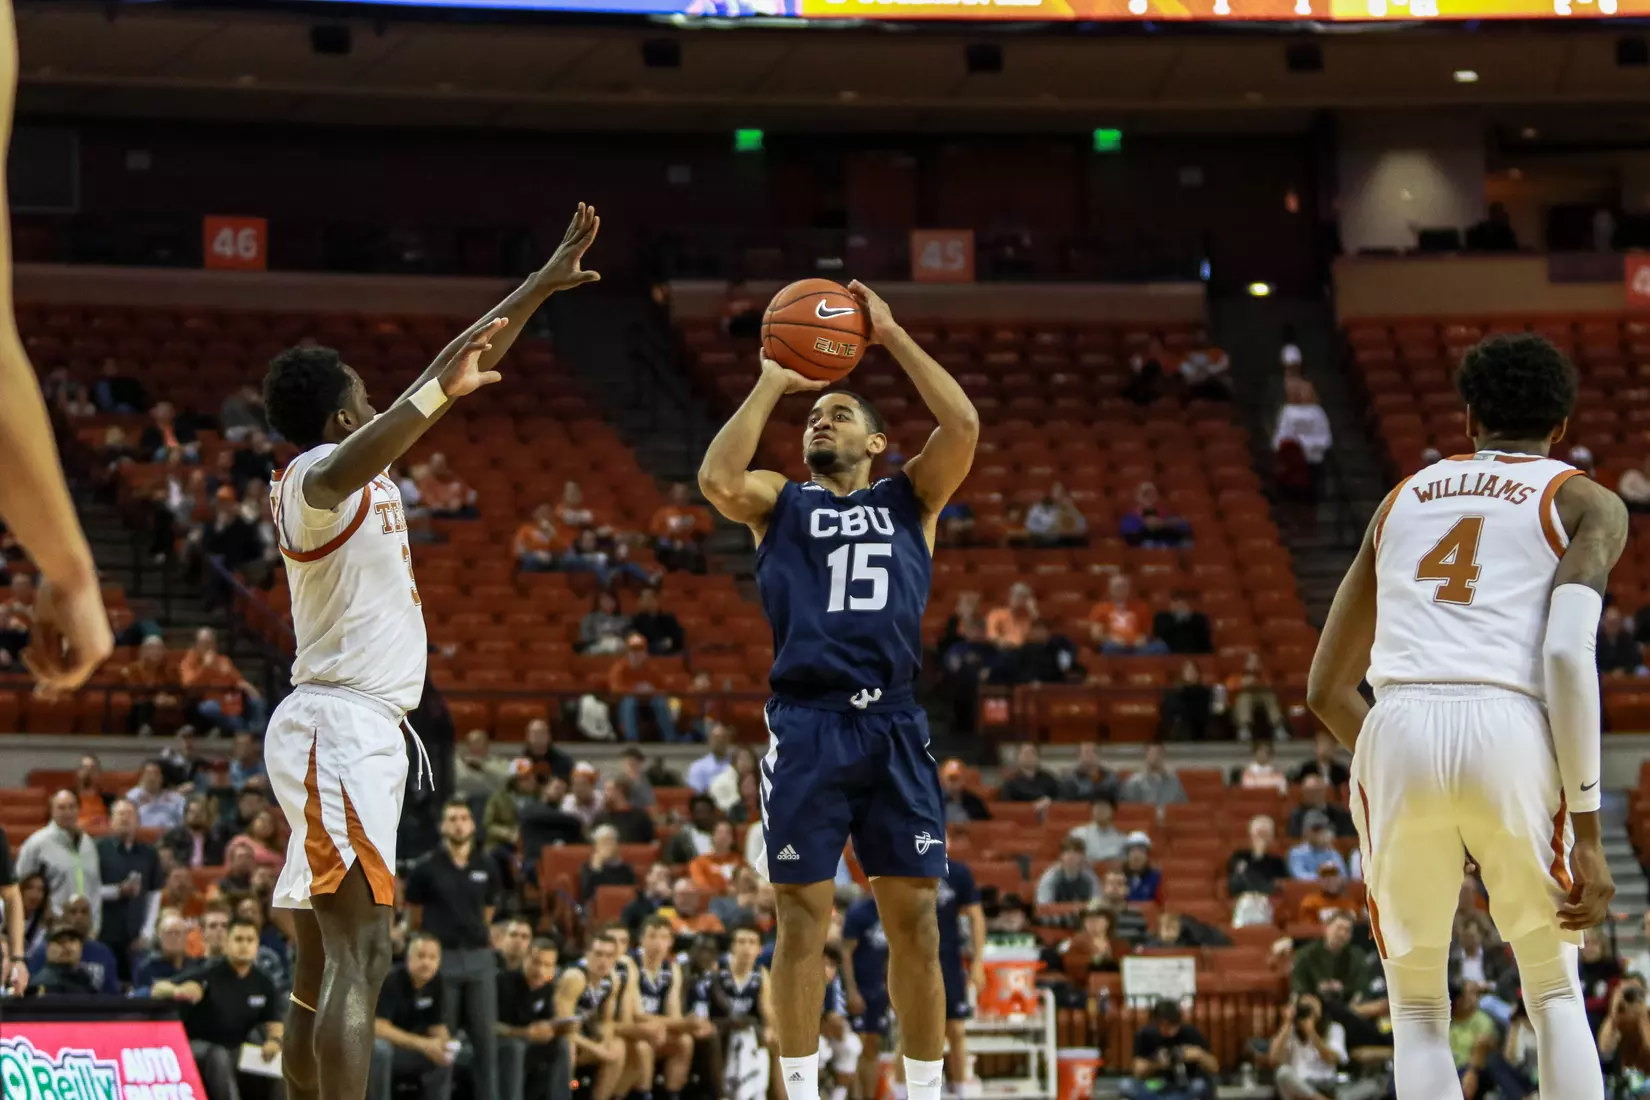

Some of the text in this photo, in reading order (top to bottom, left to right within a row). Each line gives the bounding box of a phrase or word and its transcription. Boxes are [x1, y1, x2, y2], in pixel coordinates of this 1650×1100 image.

[212, 227, 258, 259] 46
[920, 239, 964, 271] 45
[814, 337, 858, 357] ELITE
[1412, 473, 1537, 505] WILLIAMS
[810, 505, 895, 538] CBU
[1415, 513, 1485, 605] 4
[826, 543, 892, 612] 15
[121, 1046, 182, 1083] AUTO
